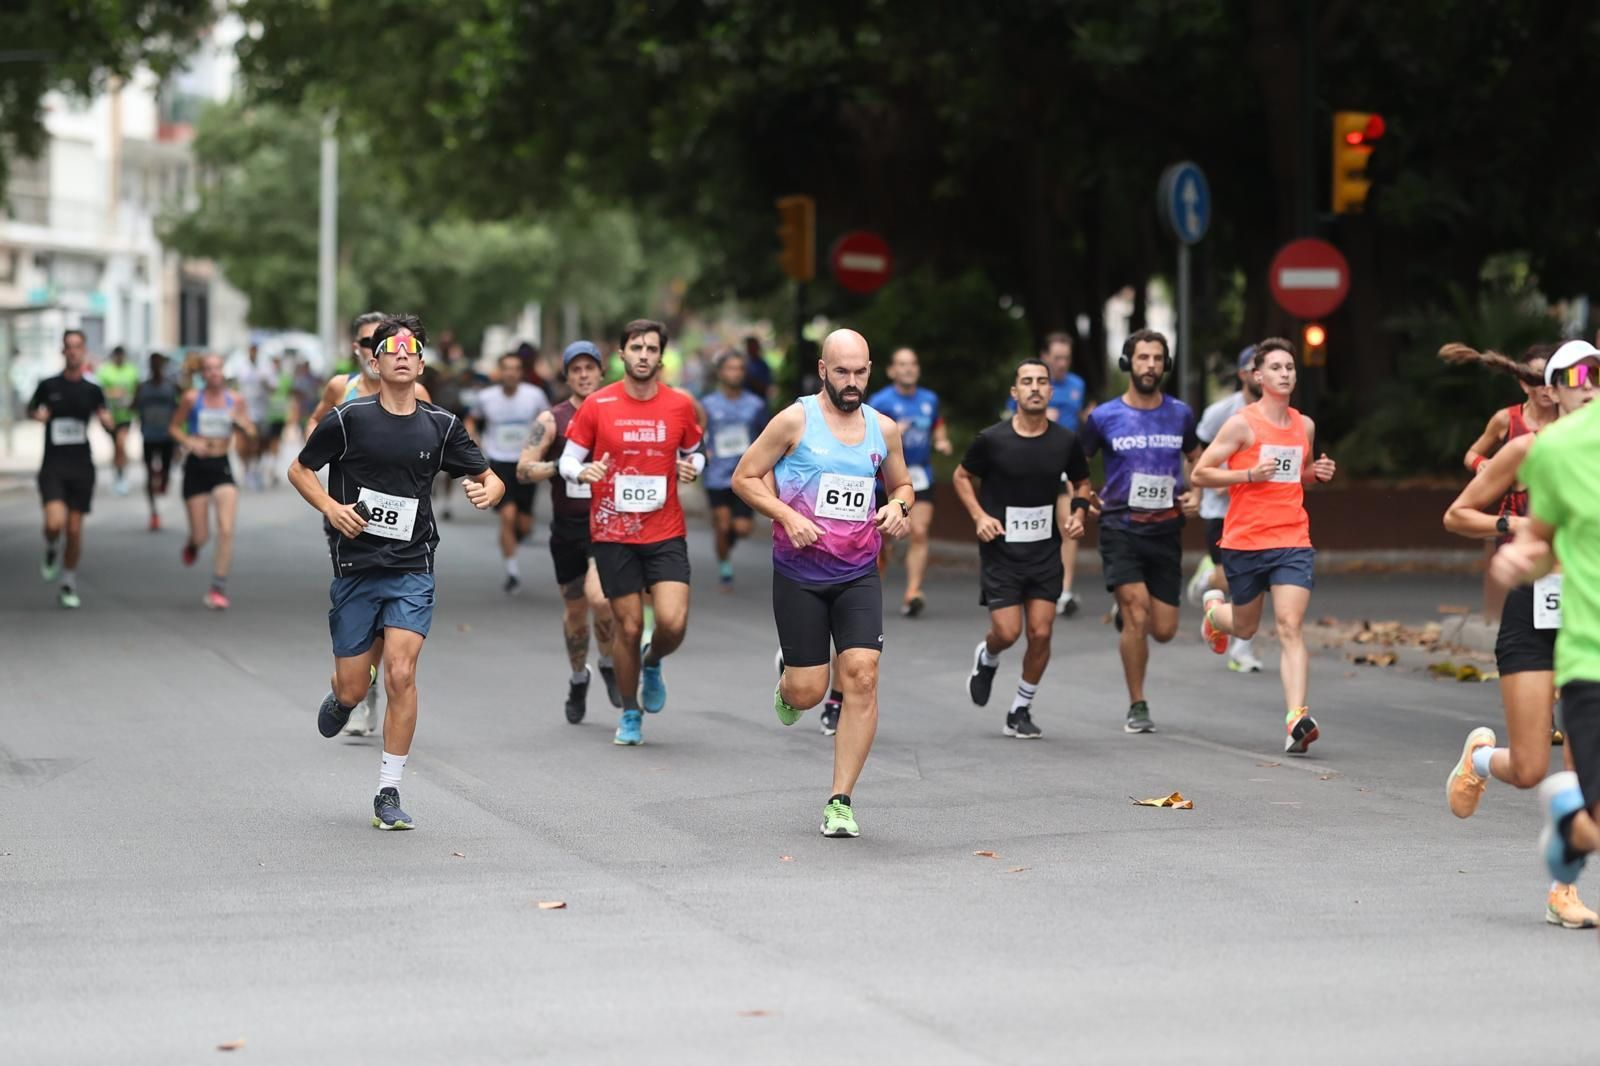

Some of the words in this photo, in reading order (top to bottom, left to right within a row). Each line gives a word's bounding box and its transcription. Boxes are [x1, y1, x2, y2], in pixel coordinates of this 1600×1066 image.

[622, 430, 656, 442] MÁLAGA
[622, 488, 657, 501] 602
[1137, 486, 1167, 498] 295
[825, 489, 865, 508] 610
[1011, 518, 1047, 530] 1197
